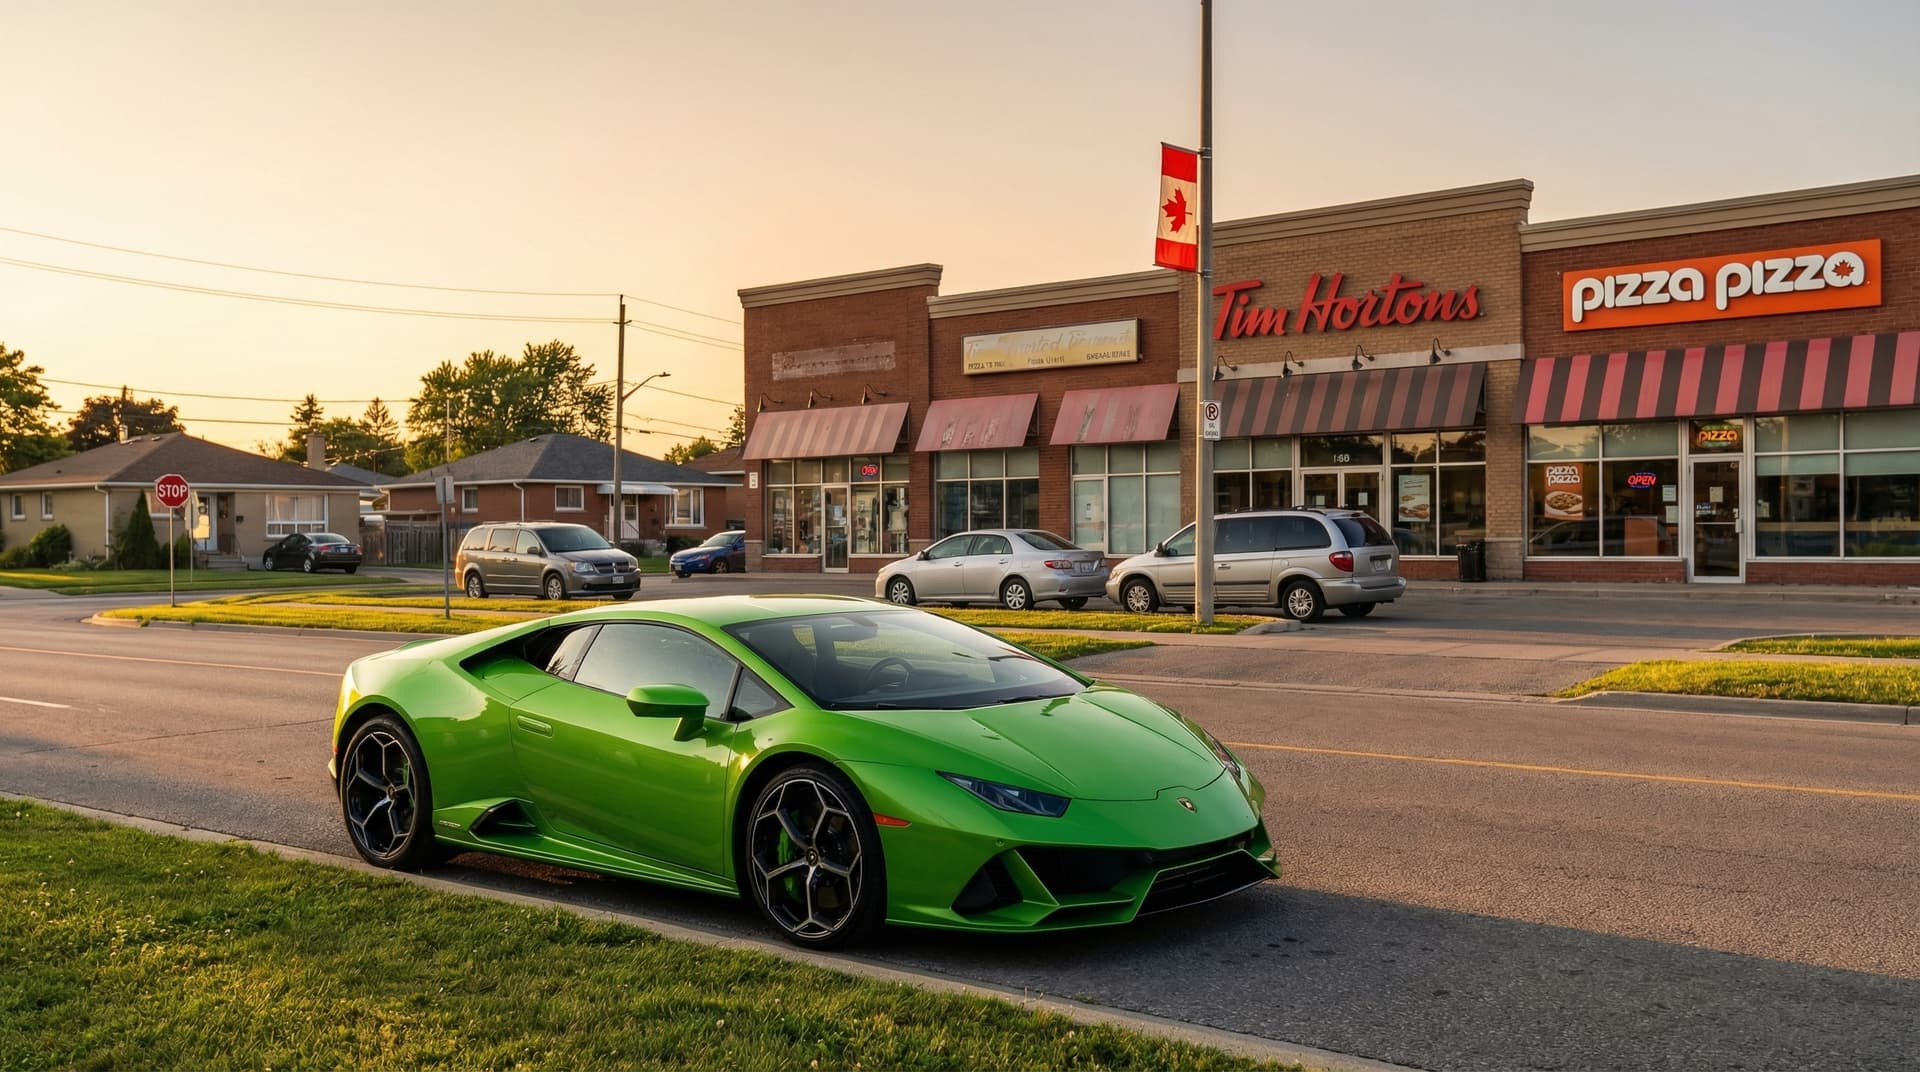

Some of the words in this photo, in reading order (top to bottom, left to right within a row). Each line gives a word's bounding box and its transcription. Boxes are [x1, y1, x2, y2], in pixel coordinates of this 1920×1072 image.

[1213, 280, 1289, 341] Tim
[1295, 272, 1480, 334] Hortons
[1572, 267, 1704, 323] pizza
[1715, 251, 1865, 311] pizza
[158, 484, 187, 498] STOP
[1627, 474, 1657, 486] OPEN
